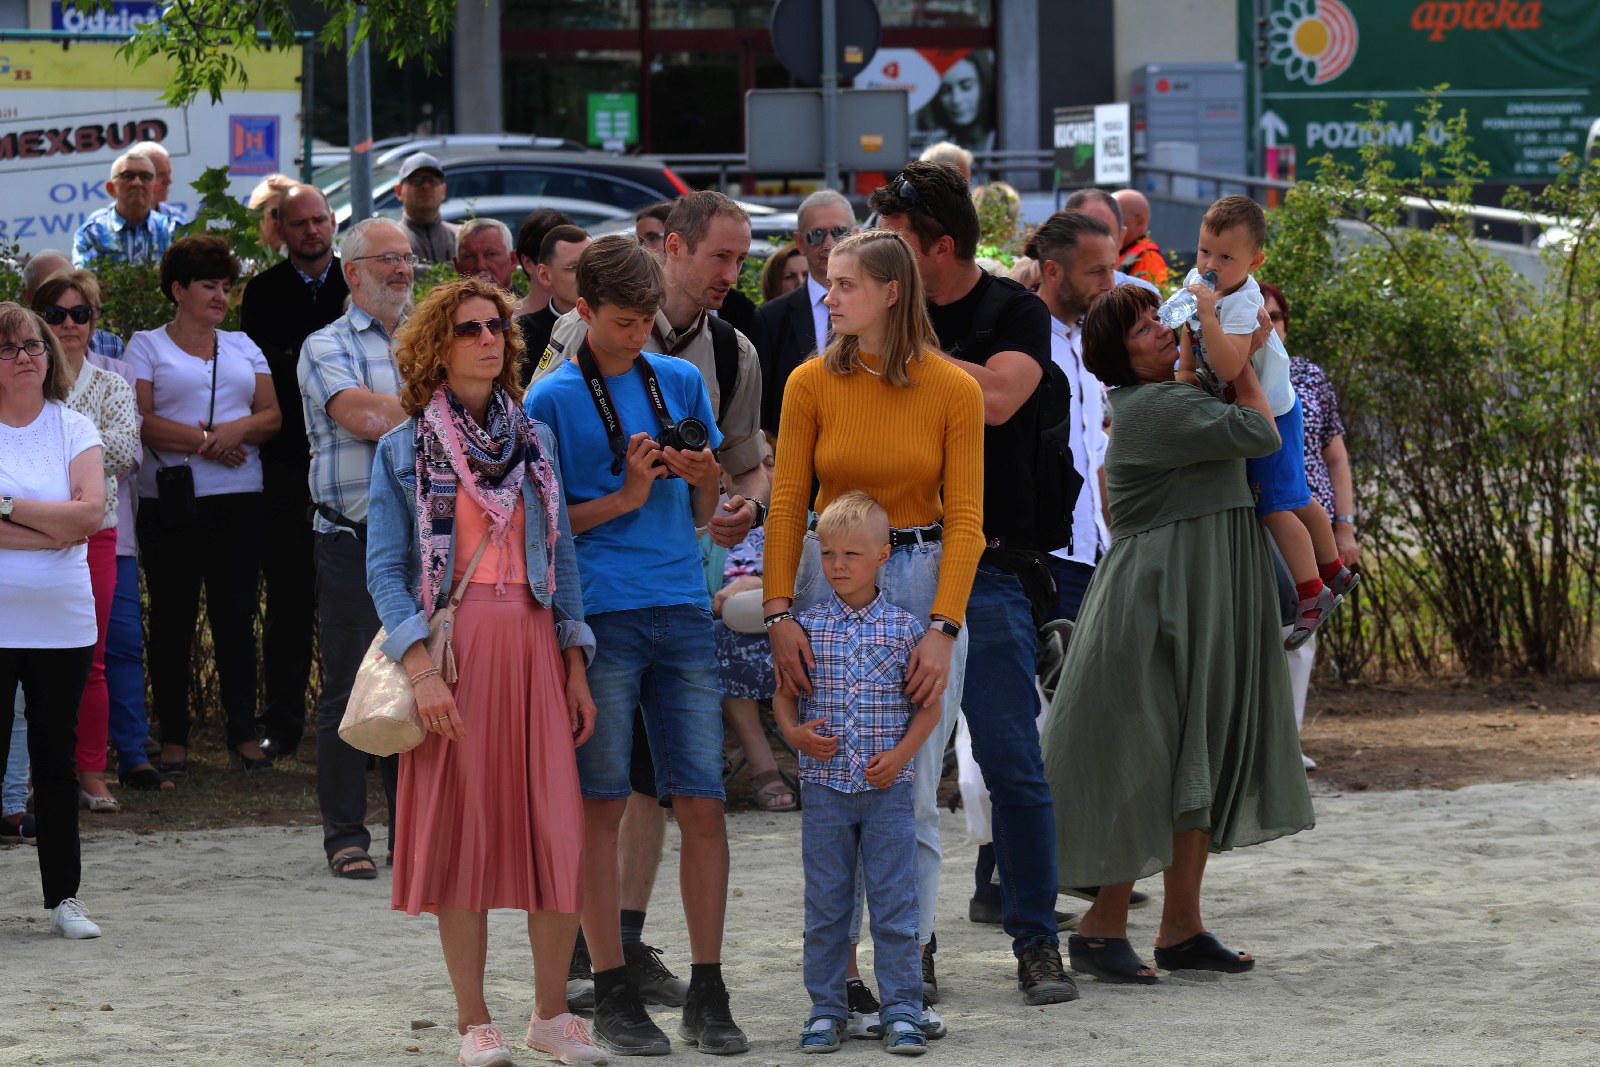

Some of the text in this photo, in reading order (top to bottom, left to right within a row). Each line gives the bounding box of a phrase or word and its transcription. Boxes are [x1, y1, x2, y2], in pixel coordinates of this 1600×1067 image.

[1410, 0, 1542, 41] apteka
[1306, 120, 1414, 149] POZIOM
[591, 378, 616, 431] EOS DIGITAL
[649, 377, 663, 409] Canon
